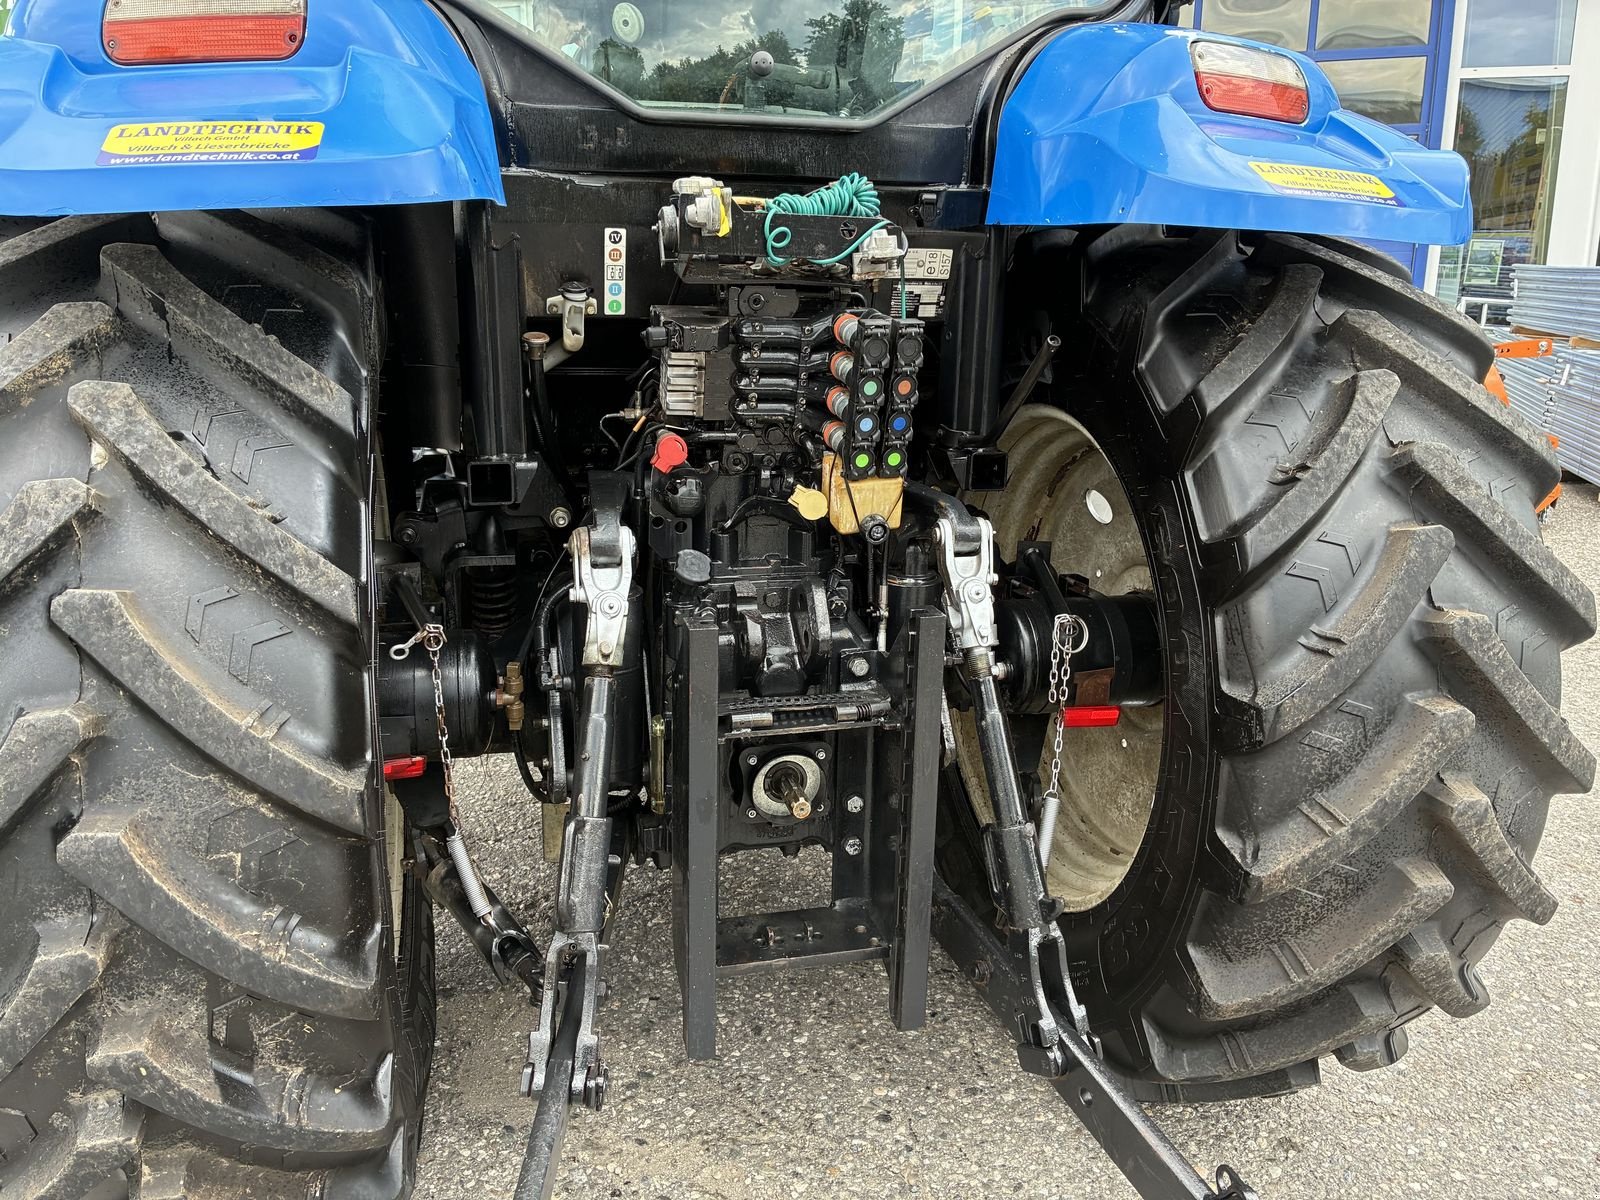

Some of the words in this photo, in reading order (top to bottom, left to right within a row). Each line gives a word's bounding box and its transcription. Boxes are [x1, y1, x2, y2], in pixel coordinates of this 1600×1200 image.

[115, 124, 314, 138] LANDTECHNIK
[128, 143, 177, 152] Villach
[195, 141, 291, 150] Lieserbrücke
[110, 152, 301, 164] www.landtechnik.co.at
[1256, 164, 1380, 186] LANDTECHNIK
[611, 234, 620, 242] IV
[611, 251, 620, 259] III
[926, 253, 938, 275] e18
[940, 253, 951, 275] S157
